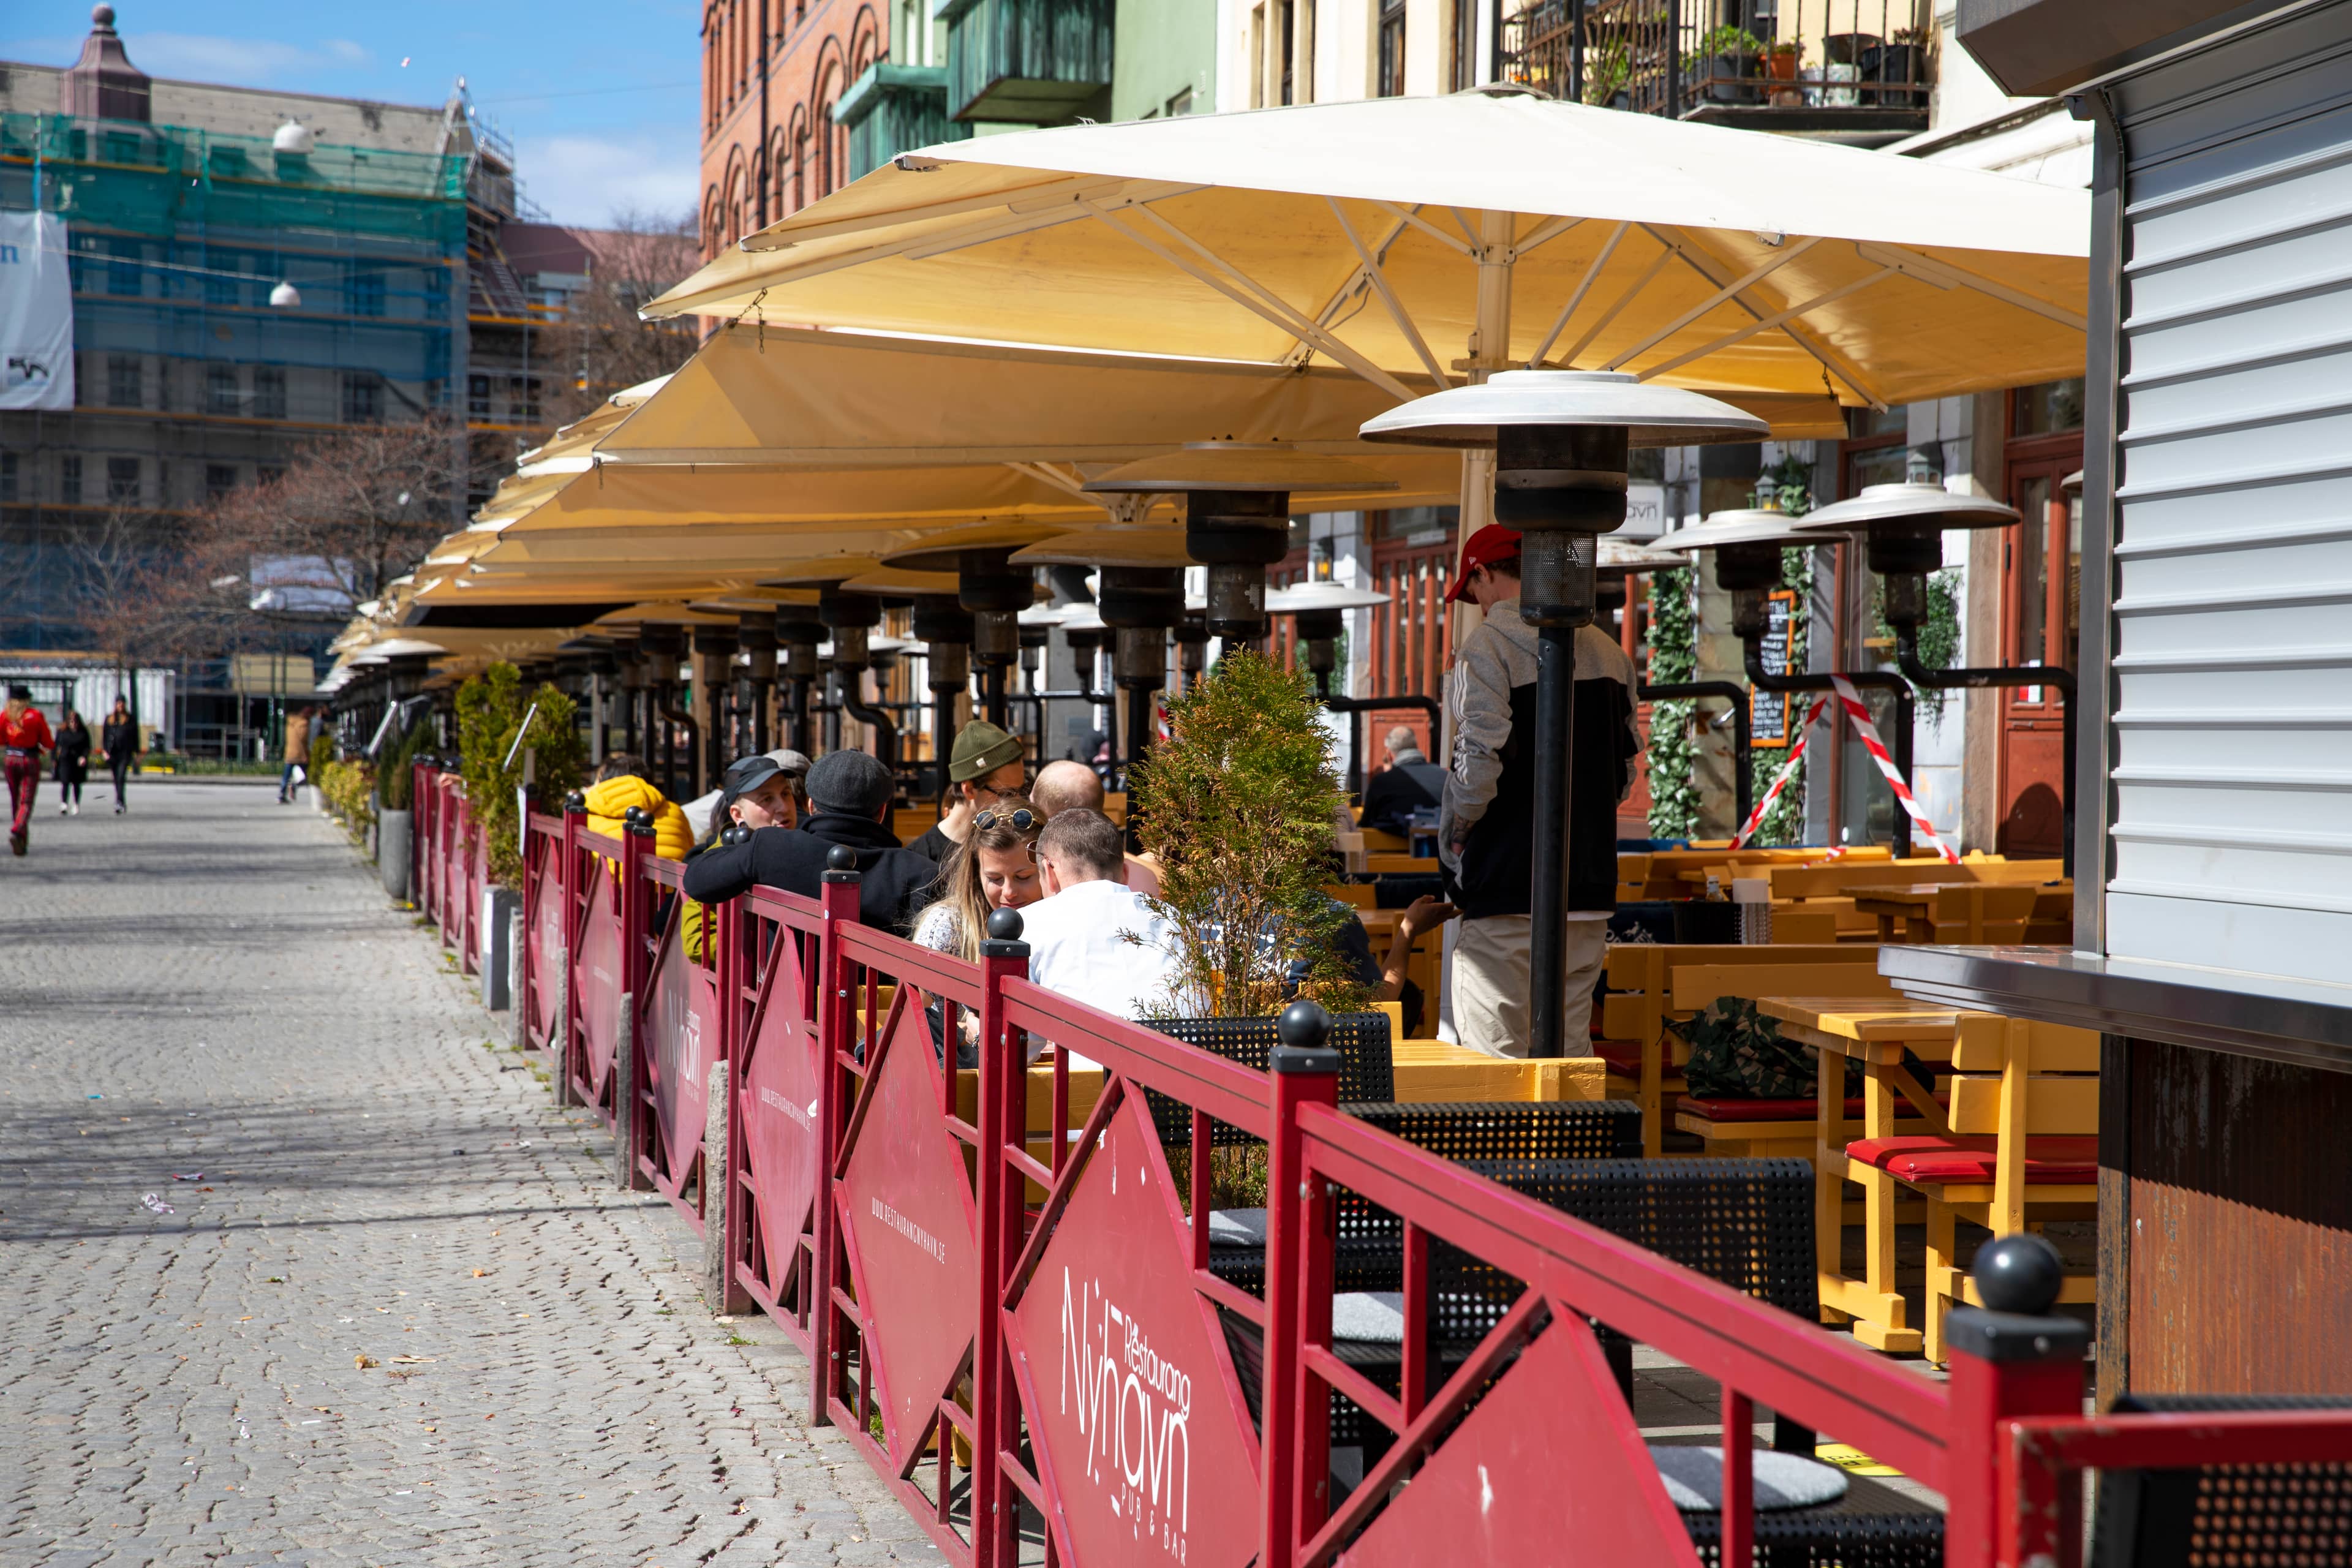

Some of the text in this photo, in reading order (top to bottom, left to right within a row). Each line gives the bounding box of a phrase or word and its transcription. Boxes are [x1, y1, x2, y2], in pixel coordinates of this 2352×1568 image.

[872, 1197, 945, 1264] WWW.RESTAURANGNYHAVN.SE
[1061, 1265, 1189, 1533] Nyhavn
[1124, 1314, 1191, 1422] Restaurang
[1121, 1482, 1186, 1567] PUB & BAR
